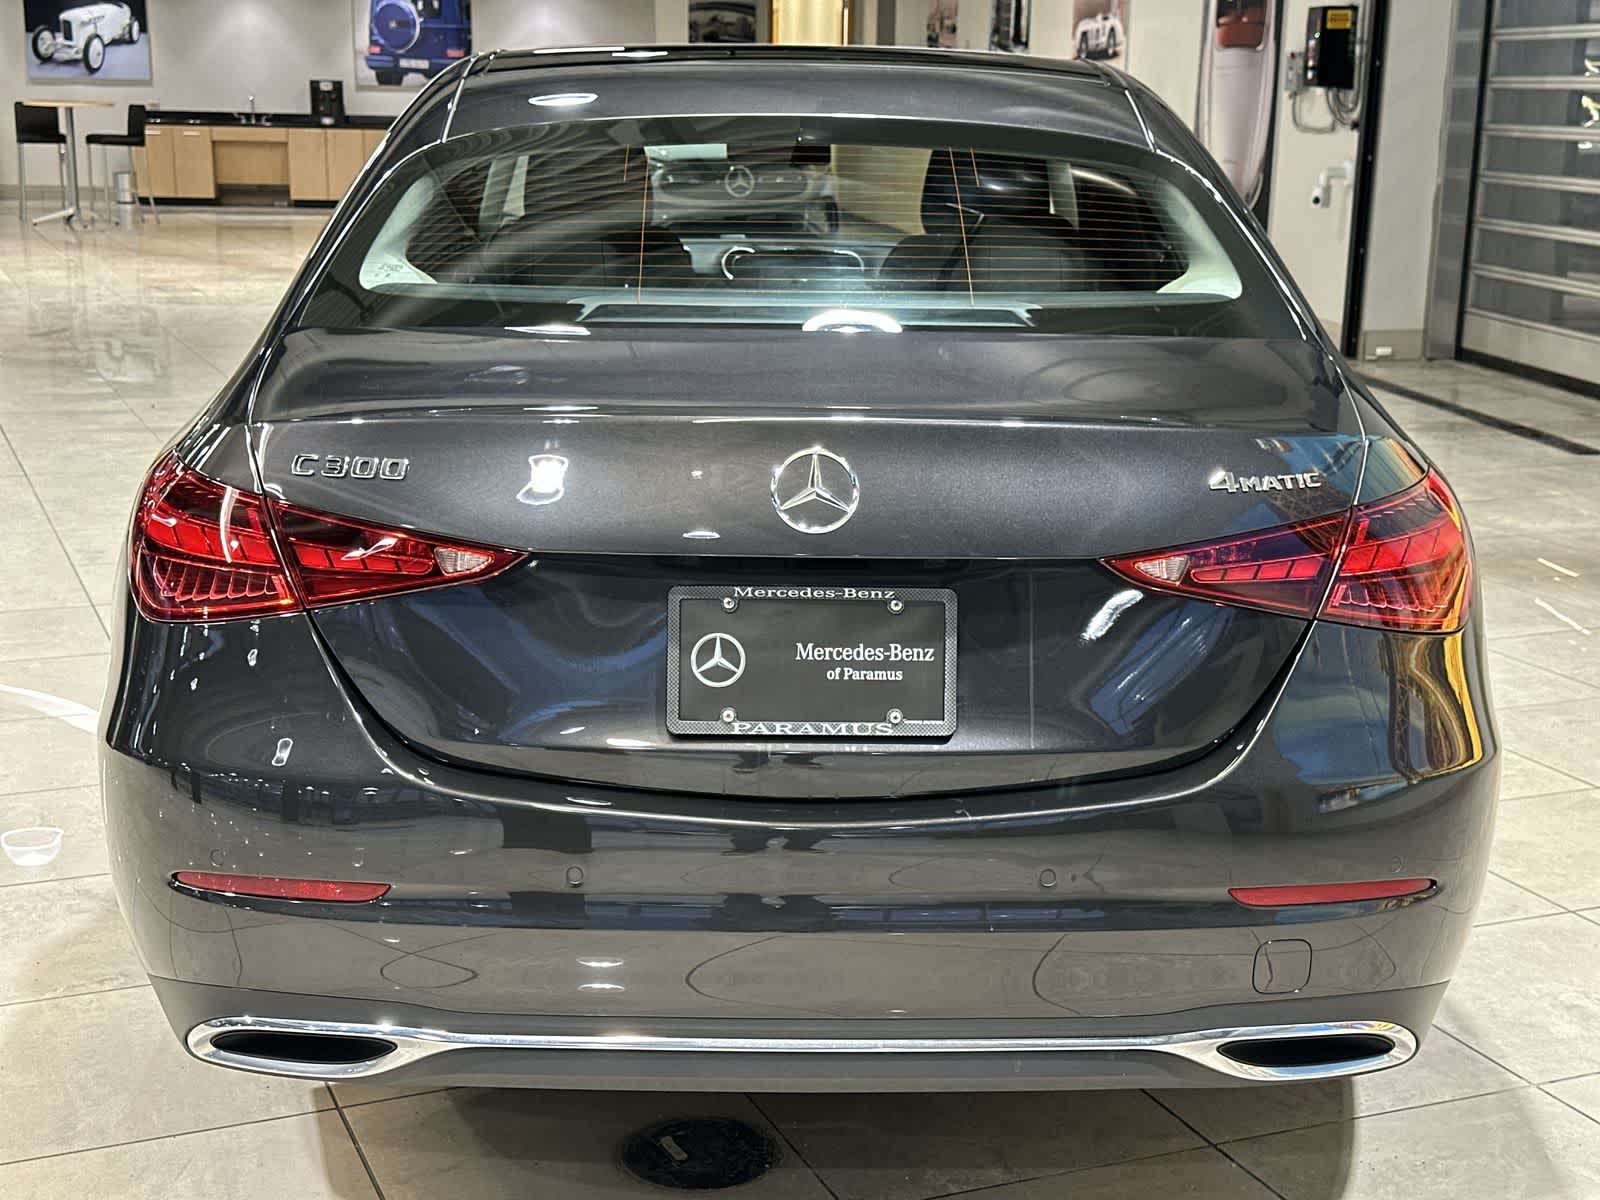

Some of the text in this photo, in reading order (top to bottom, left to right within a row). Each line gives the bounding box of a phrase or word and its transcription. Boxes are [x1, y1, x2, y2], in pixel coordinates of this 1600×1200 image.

[1208, 467, 1322, 492] 4MATIC
[733, 587, 896, 600] Mercedes-Benz
[795, 643, 935, 662] Mercedes-Benz
[826, 668, 904, 681] of Paramus
[731, 722, 895, 736] PARAMUS
